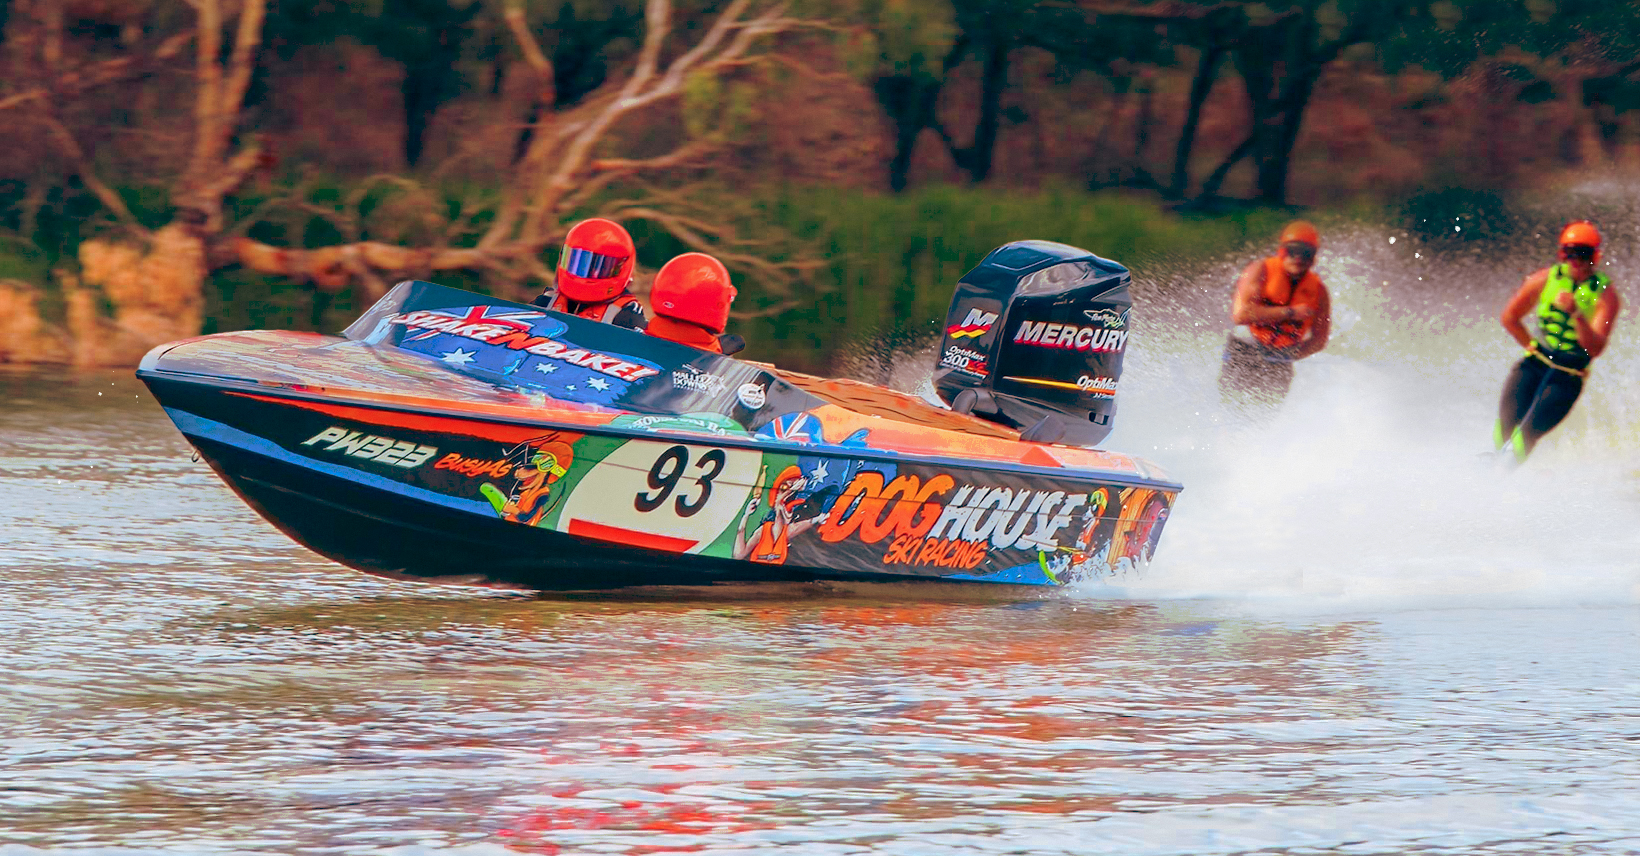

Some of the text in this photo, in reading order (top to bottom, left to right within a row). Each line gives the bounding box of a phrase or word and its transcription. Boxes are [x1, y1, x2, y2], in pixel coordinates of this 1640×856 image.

[949, 345, 986, 361] OptiMax
[1014, 321, 1129, 352] MERCURY
[301, 426, 438, 468] PW323
[634, 444, 726, 518] 93
[883, 533, 988, 569] SKI RACING
